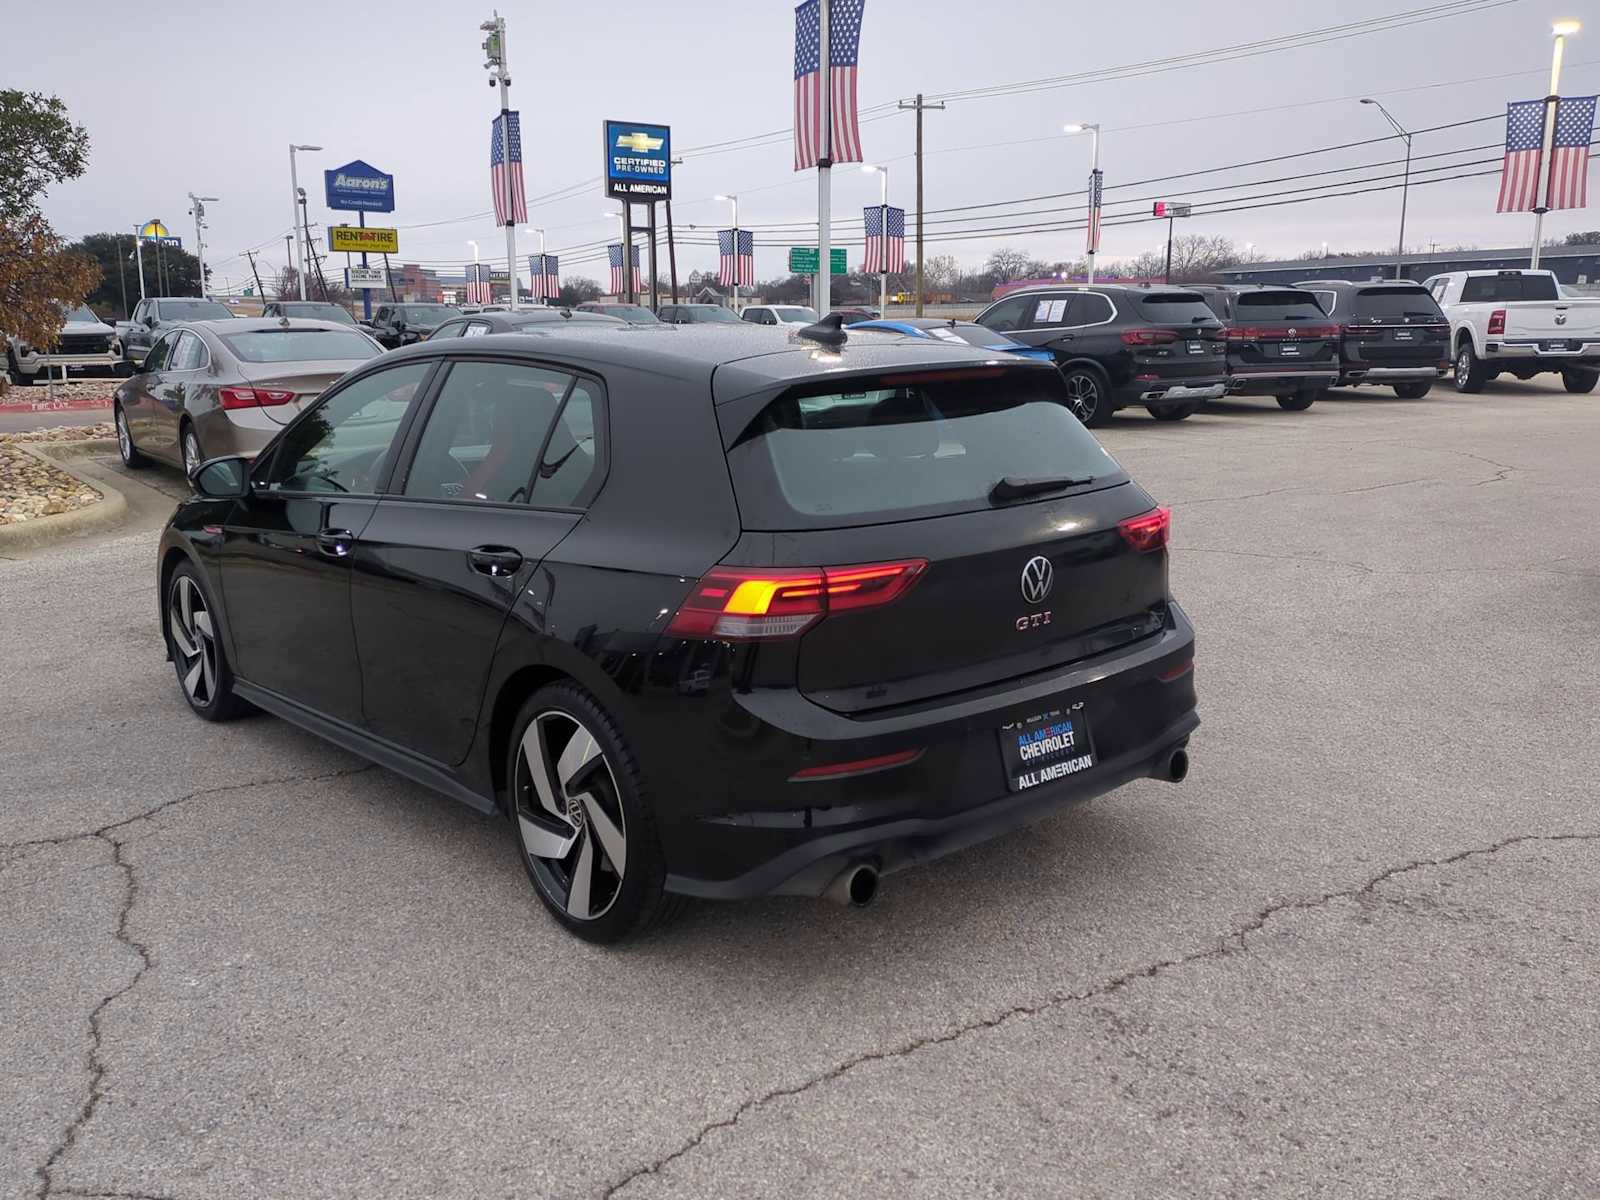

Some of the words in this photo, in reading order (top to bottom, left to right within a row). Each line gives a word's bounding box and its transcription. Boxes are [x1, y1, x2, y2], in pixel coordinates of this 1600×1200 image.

[614, 157, 666, 167] CERTIFIED
[616, 165, 664, 174] PRE-OWNED
[335, 173, 388, 190] Aaron's
[614, 183, 628, 192] ALL
[629, 184, 667, 194] AMERICAN
[1016, 611, 1051, 630] GTI
[1018, 734, 1033, 746] ALL
[1034, 720, 1073, 740] AMERICAN
[1020, 731, 1075, 761] CHEVROLET
[1019, 773, 1039, 790] ALL
[1040, 754, 1093, 783] AMERICAN
